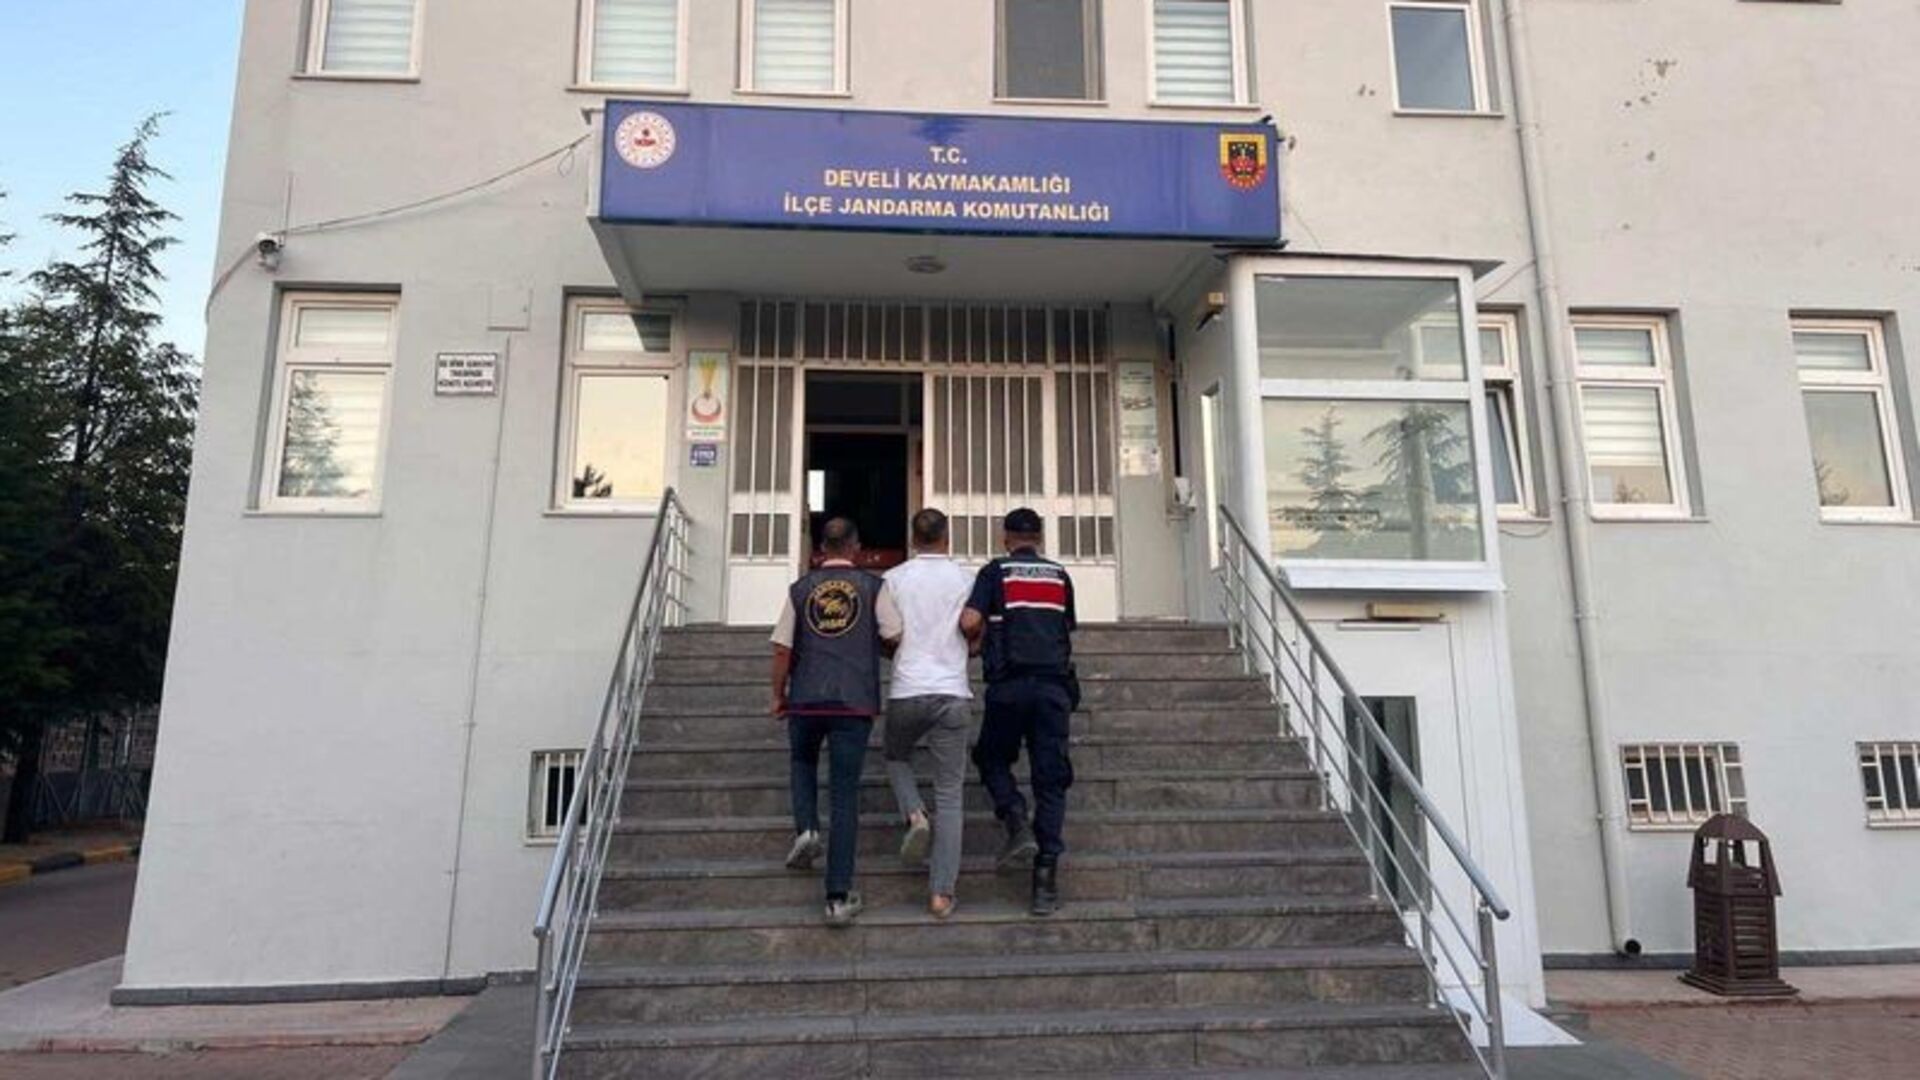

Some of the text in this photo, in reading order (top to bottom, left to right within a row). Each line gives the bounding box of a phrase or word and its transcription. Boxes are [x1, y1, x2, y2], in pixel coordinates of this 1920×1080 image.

[930, 146, 967, 164] T.C.
[824, 168, 1071, 194] DEVELİ KAYMAKAMLIĞI
[784, 192, 1110, 223] İLÇE JANDARMA KOMUTANLIĞI
